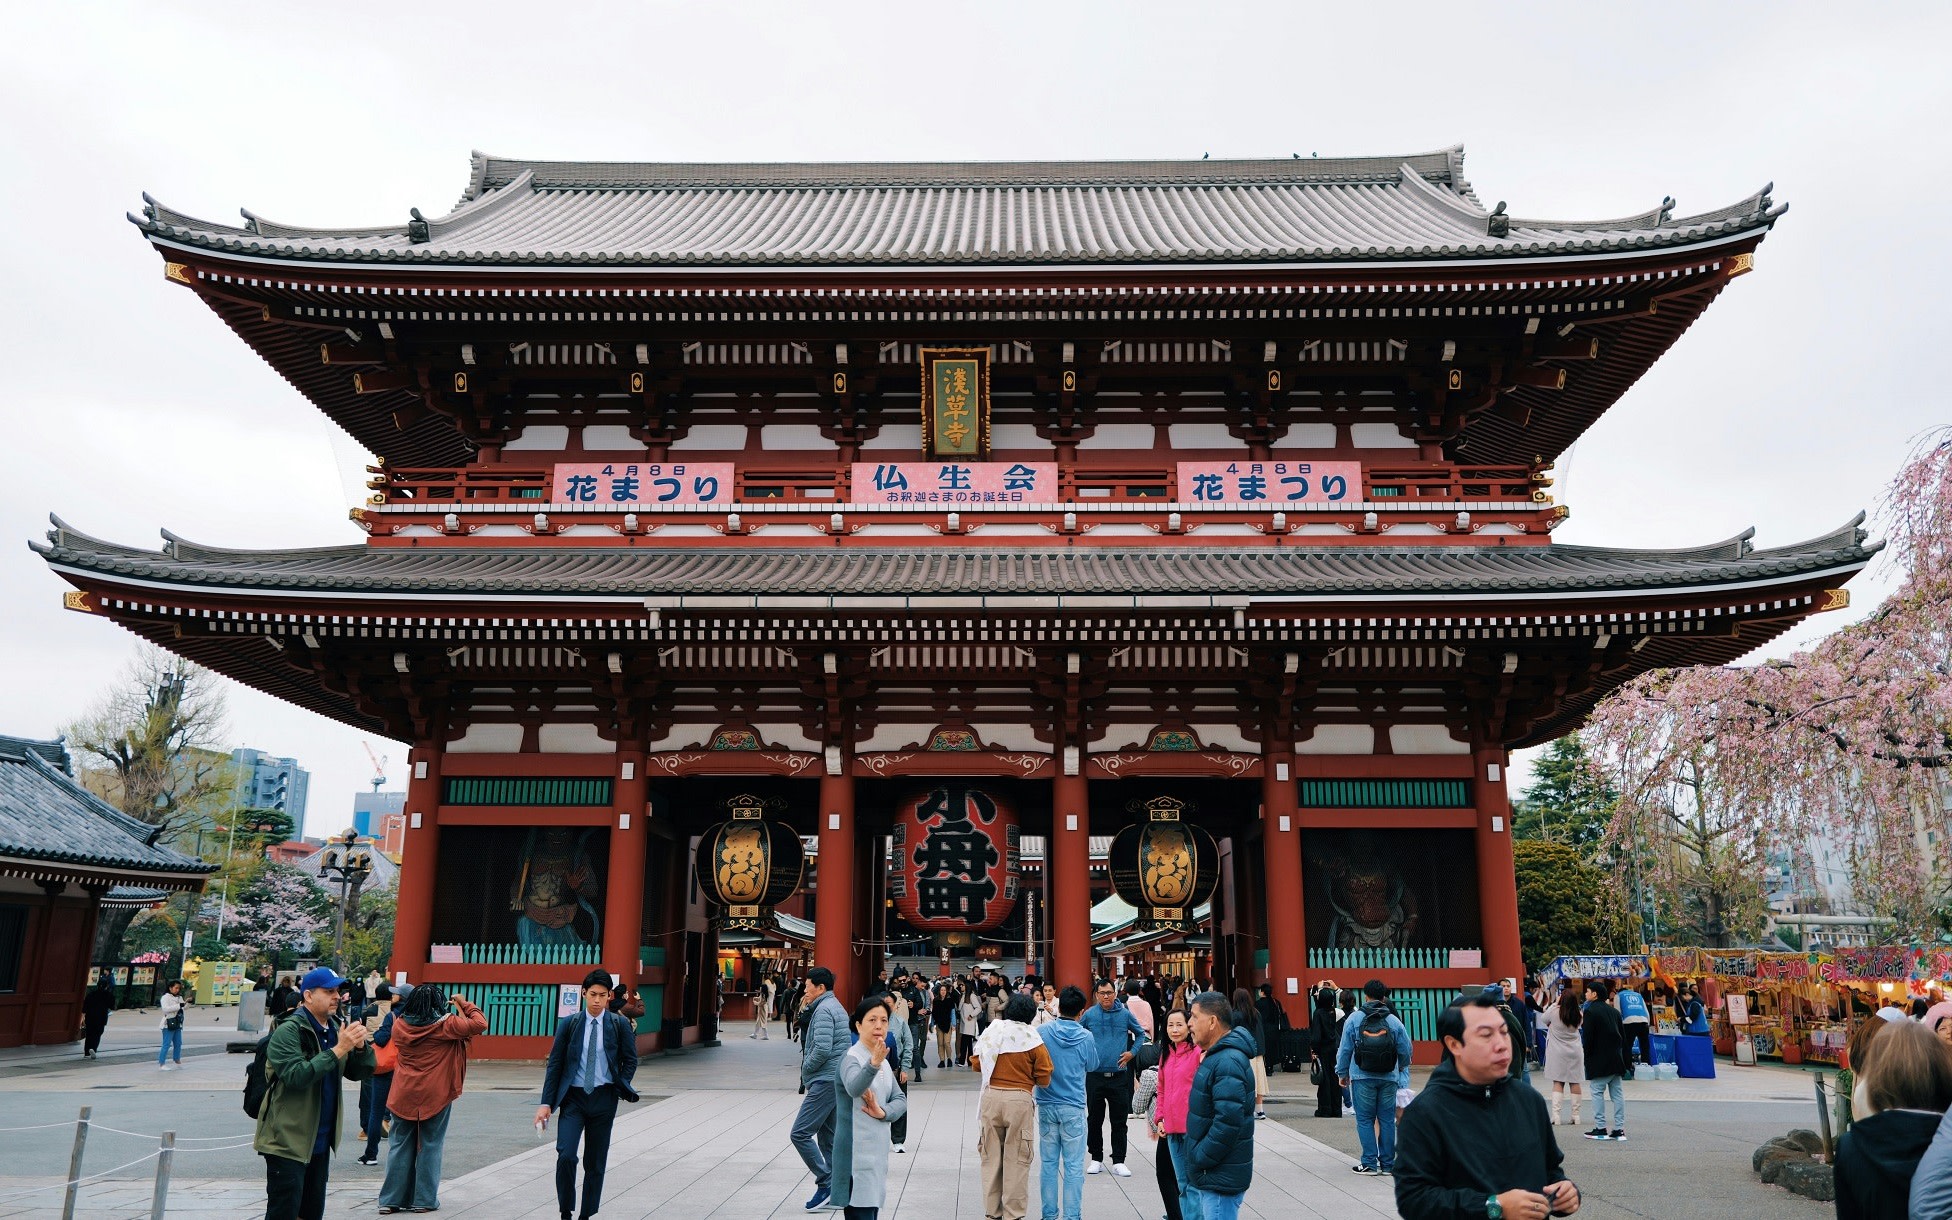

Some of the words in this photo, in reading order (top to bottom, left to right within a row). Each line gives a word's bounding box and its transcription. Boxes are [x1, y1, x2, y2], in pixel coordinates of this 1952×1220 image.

[601, 464, 686, 476] 4月8日
[872, 464, 1037, 491] 仏生会
[1226, 463, 1312, 475] 4月8日
[565, 475, 718, 502] 花まつり
[886, 491, 1023, 502] お釈迦さまのお誕生日
[1192, 474, 1347, 501] 花まつり
[912, 789, 1000, 925] 小舟町
